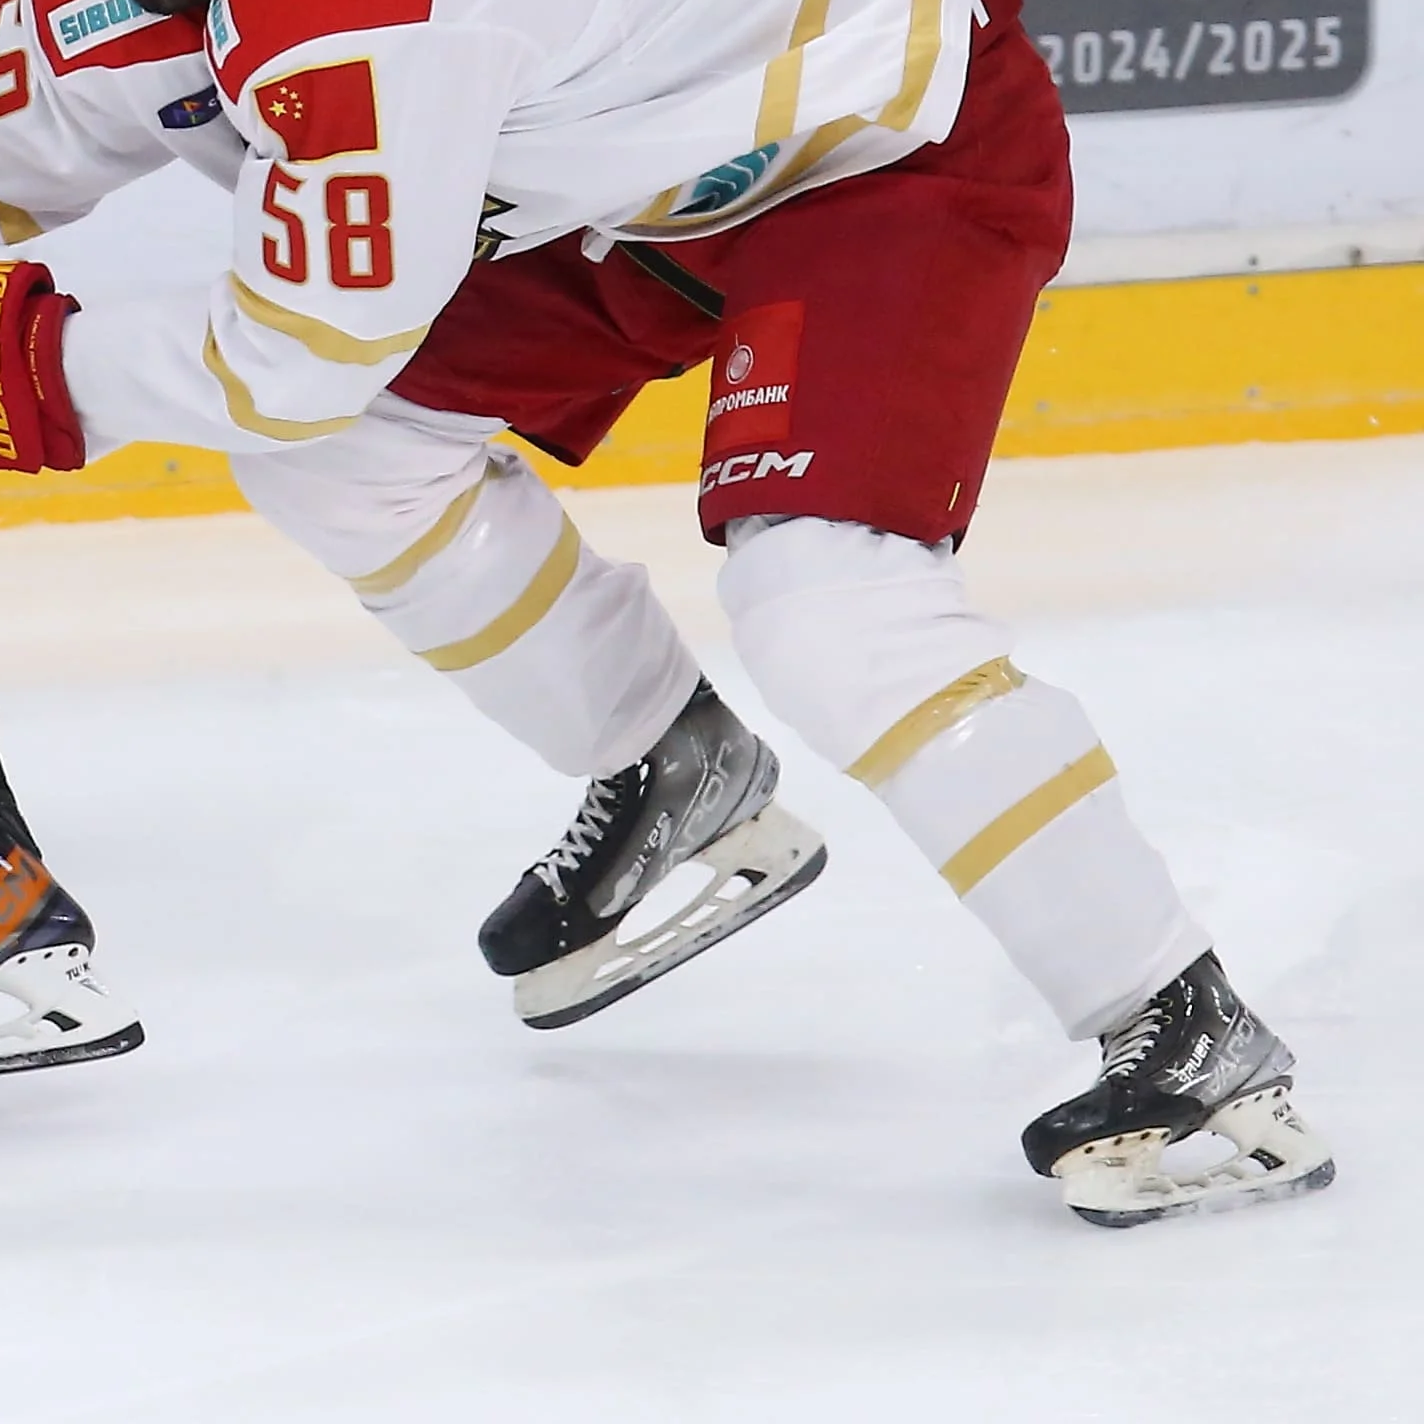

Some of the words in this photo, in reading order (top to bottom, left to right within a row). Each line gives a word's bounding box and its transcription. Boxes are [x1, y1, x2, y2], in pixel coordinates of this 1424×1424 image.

[1037, 15, 1343, 85] 2024/2025
[259, 162, 397, 291] 58
[701, 451, 815, 496] CCM
